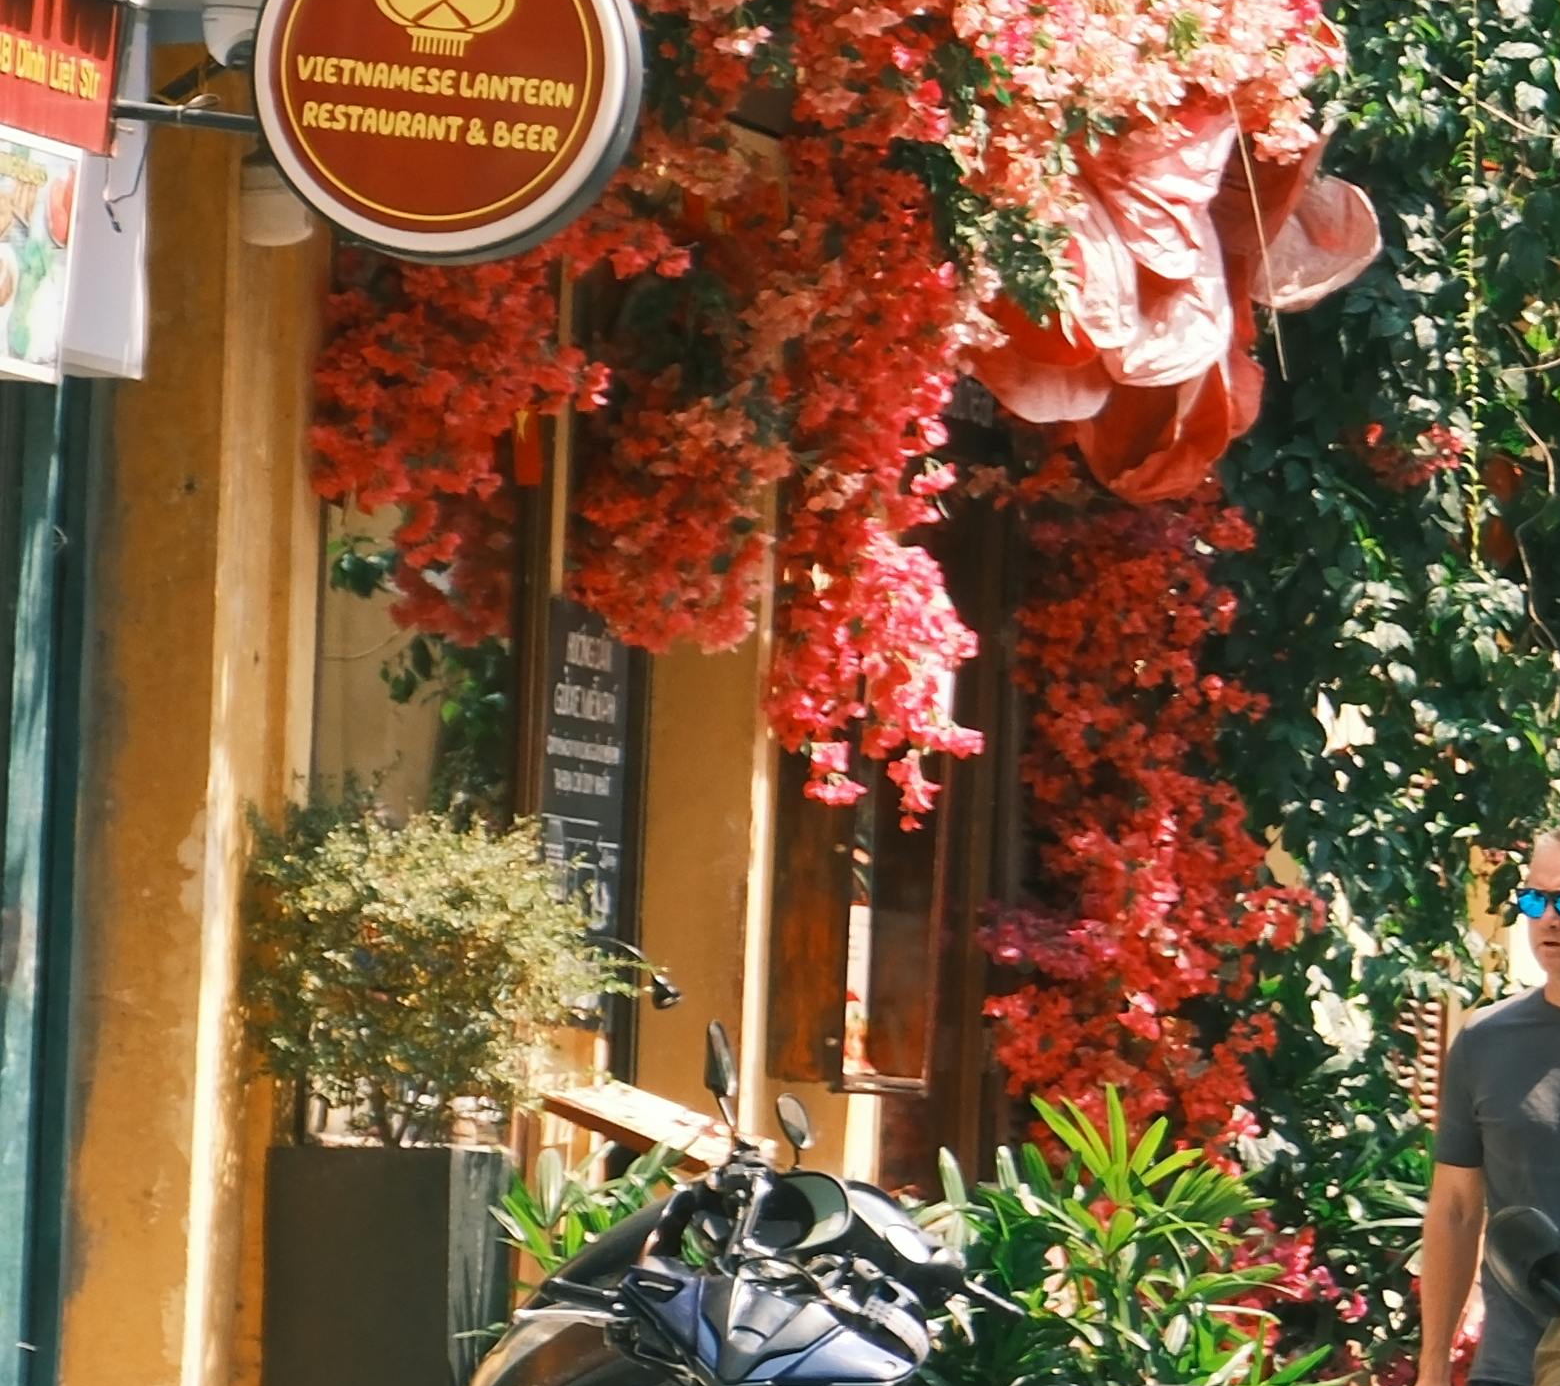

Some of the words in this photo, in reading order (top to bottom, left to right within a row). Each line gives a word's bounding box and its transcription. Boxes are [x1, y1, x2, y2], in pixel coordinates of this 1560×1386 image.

[296, 53, 456, 96] VIETNAMESE
[459, 69, 575, 109] LANTERN
[301, 100, 464, 143] RESTAURANT
[464, 117, 488, 147] &
[492, 119, 560, 153] BEER
